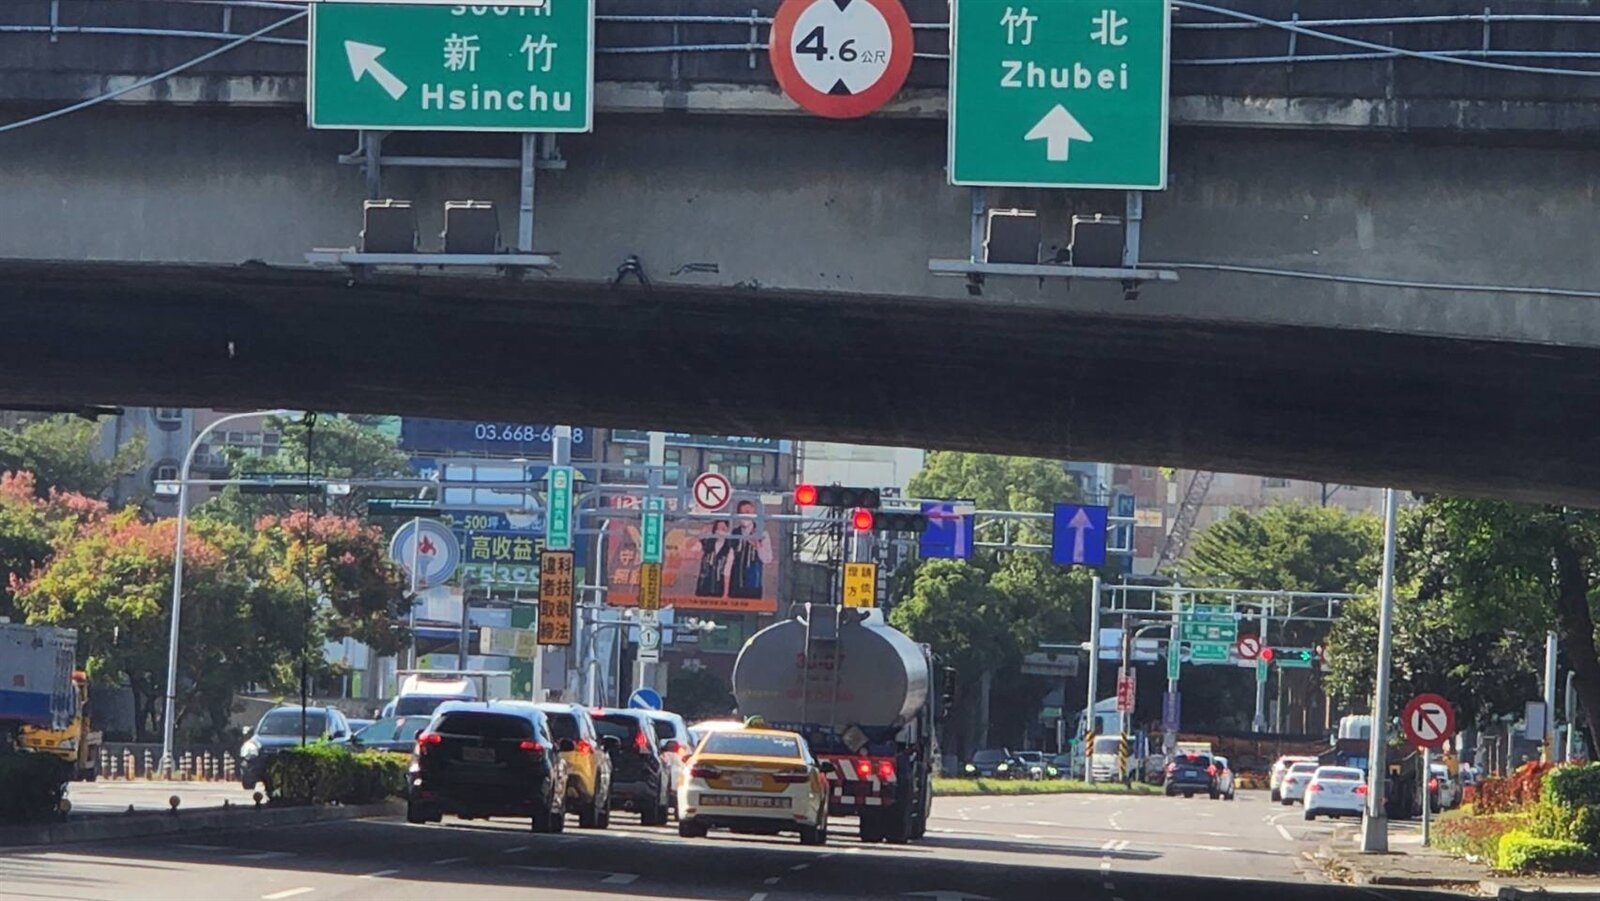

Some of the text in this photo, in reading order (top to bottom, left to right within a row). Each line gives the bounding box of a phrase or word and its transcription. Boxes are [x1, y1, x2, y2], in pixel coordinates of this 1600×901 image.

[795, 25, 858, 63] 4.6
[1000, 7, 1129, 47] 竹北
[443, 33, 558, 73] 新竹
[1000, 60, 1129, 91] Zhubei
[420, 83, 573, 112] Hsinchu
[475, 423, 584, 444] 03.668-68
